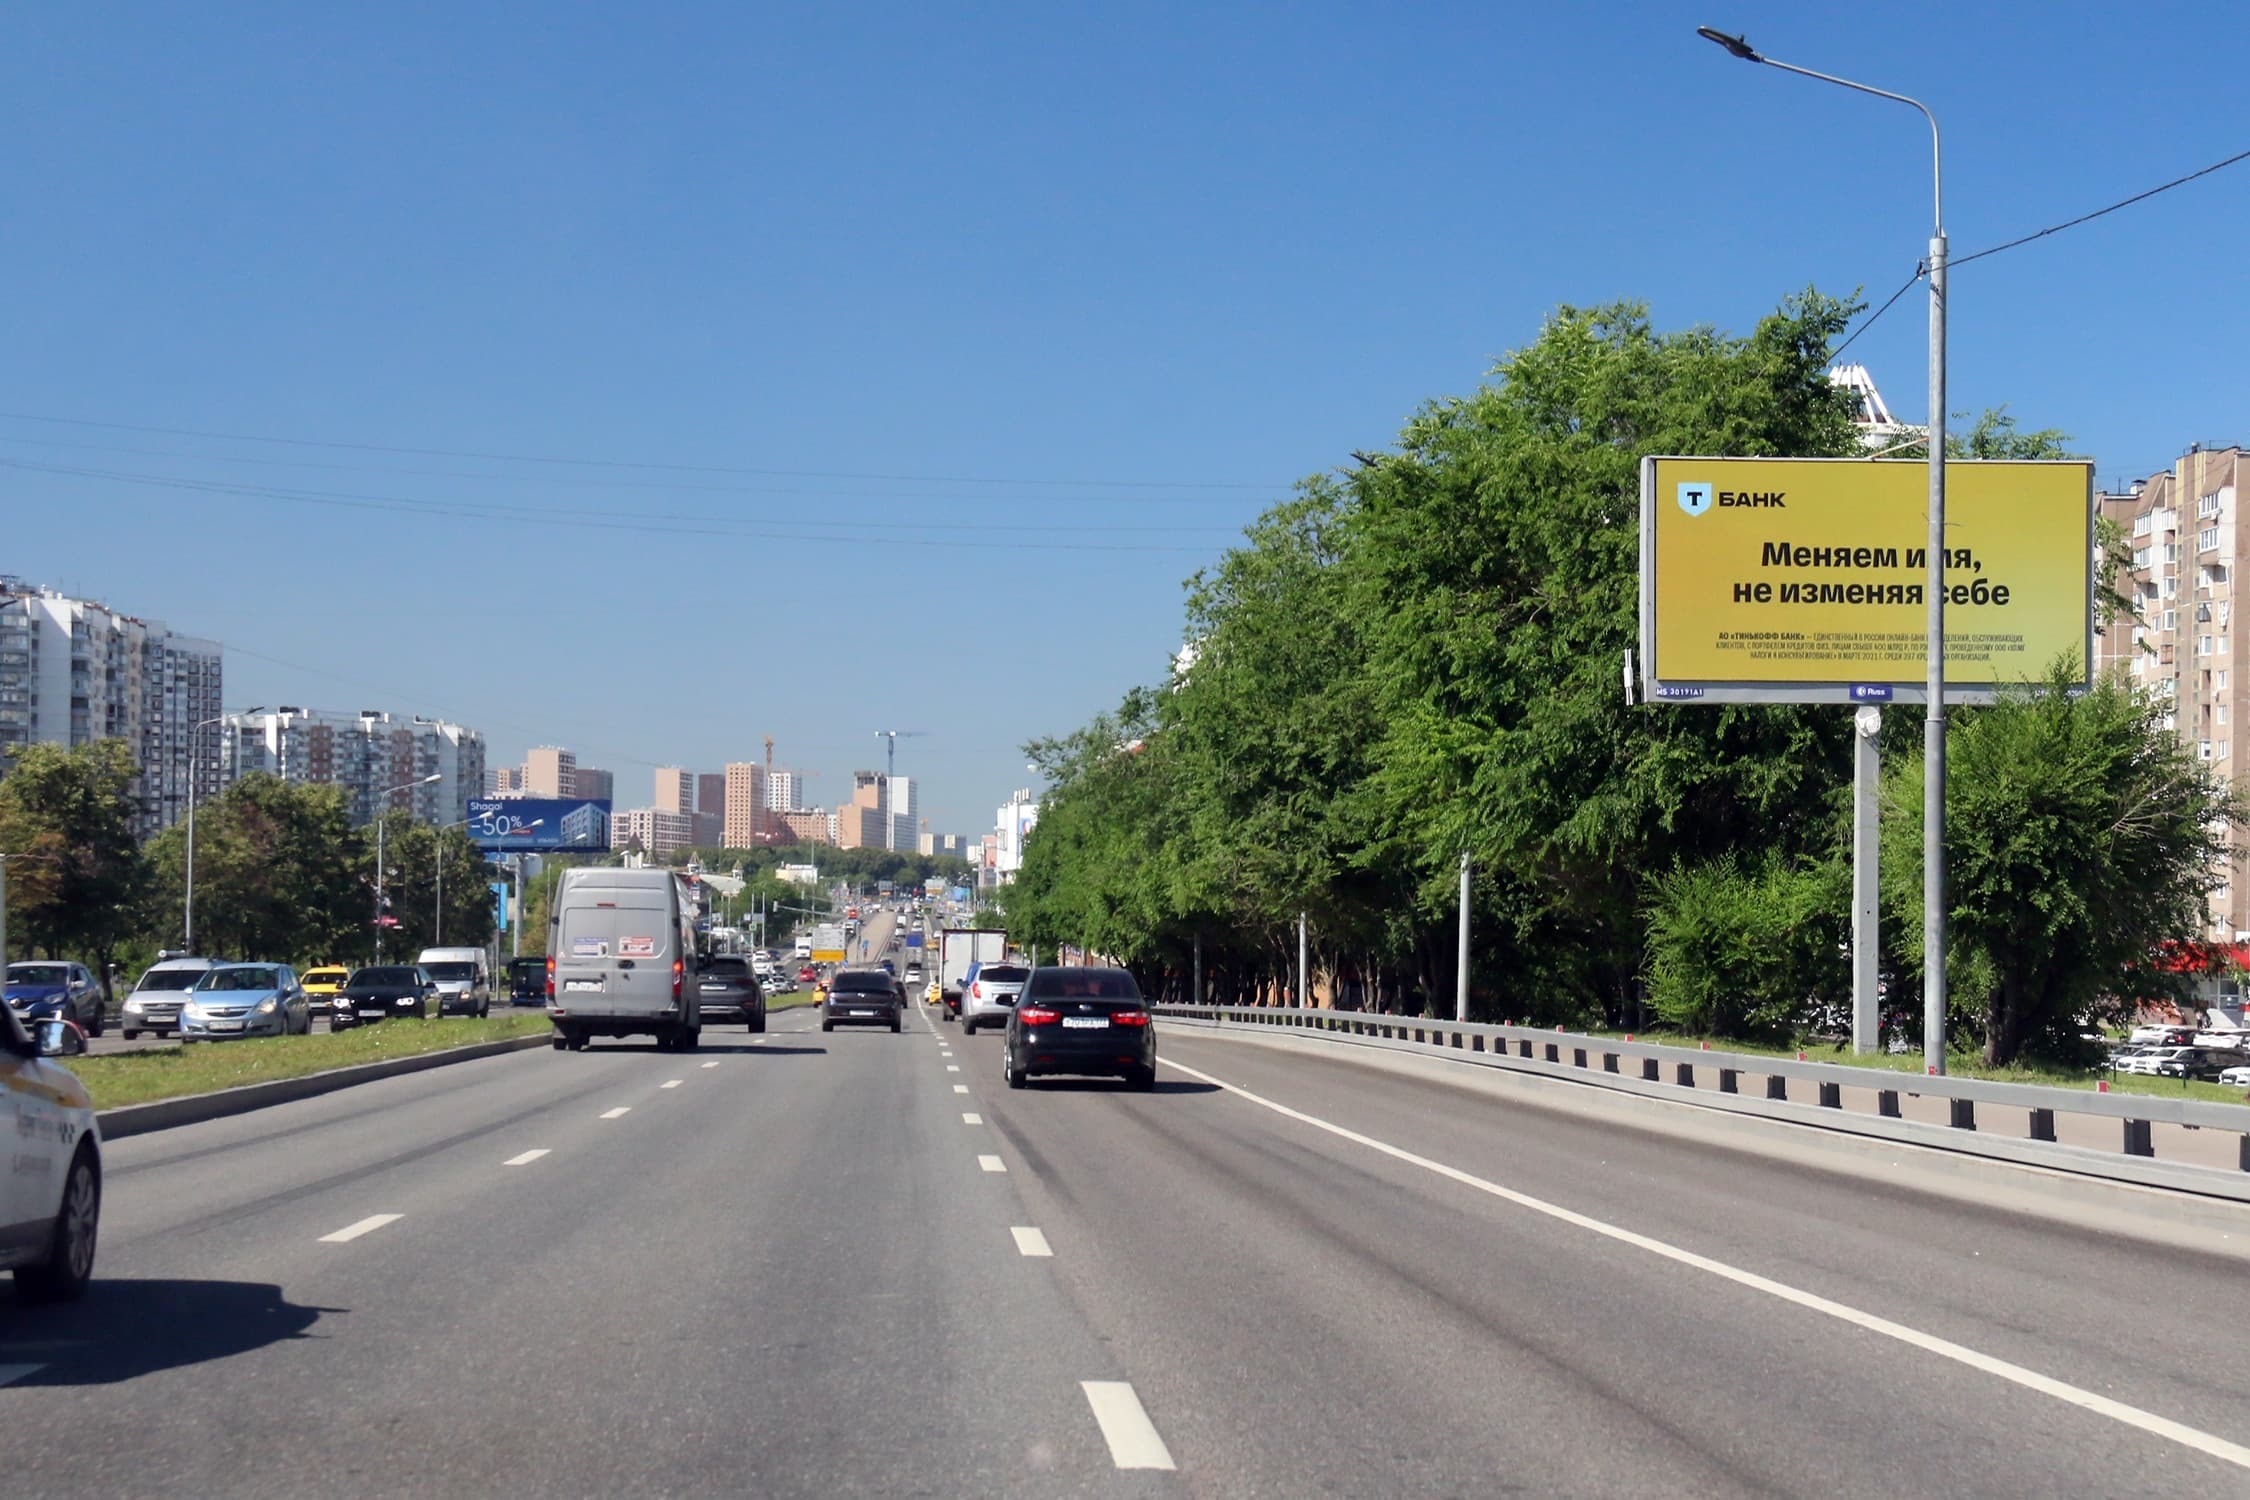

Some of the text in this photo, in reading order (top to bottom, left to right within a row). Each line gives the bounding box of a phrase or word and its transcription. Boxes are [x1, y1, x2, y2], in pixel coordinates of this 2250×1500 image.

[1687, 492, 1786, 507] Т БАНК
[1761, 542, 1898, 568] Меняем
[1733, 584, 1772, 604] не
[1779, 584, 1923, 604] изменяя
[1718, 632, 1729, 640] АО
[1731, 632, 1779, 641] «ТИНЬКОФФ
[1780, 632, 1805, 641] БАНК»
[1864, 633, 1885, 641] РОССИИ
[1752, 642, 1785, 650] ПОРТФЕЛЕМ
[1786, 642, 1815, 650] КРЕДИТОВ
[1842, 652, 1860, 660] МАРТЕ
